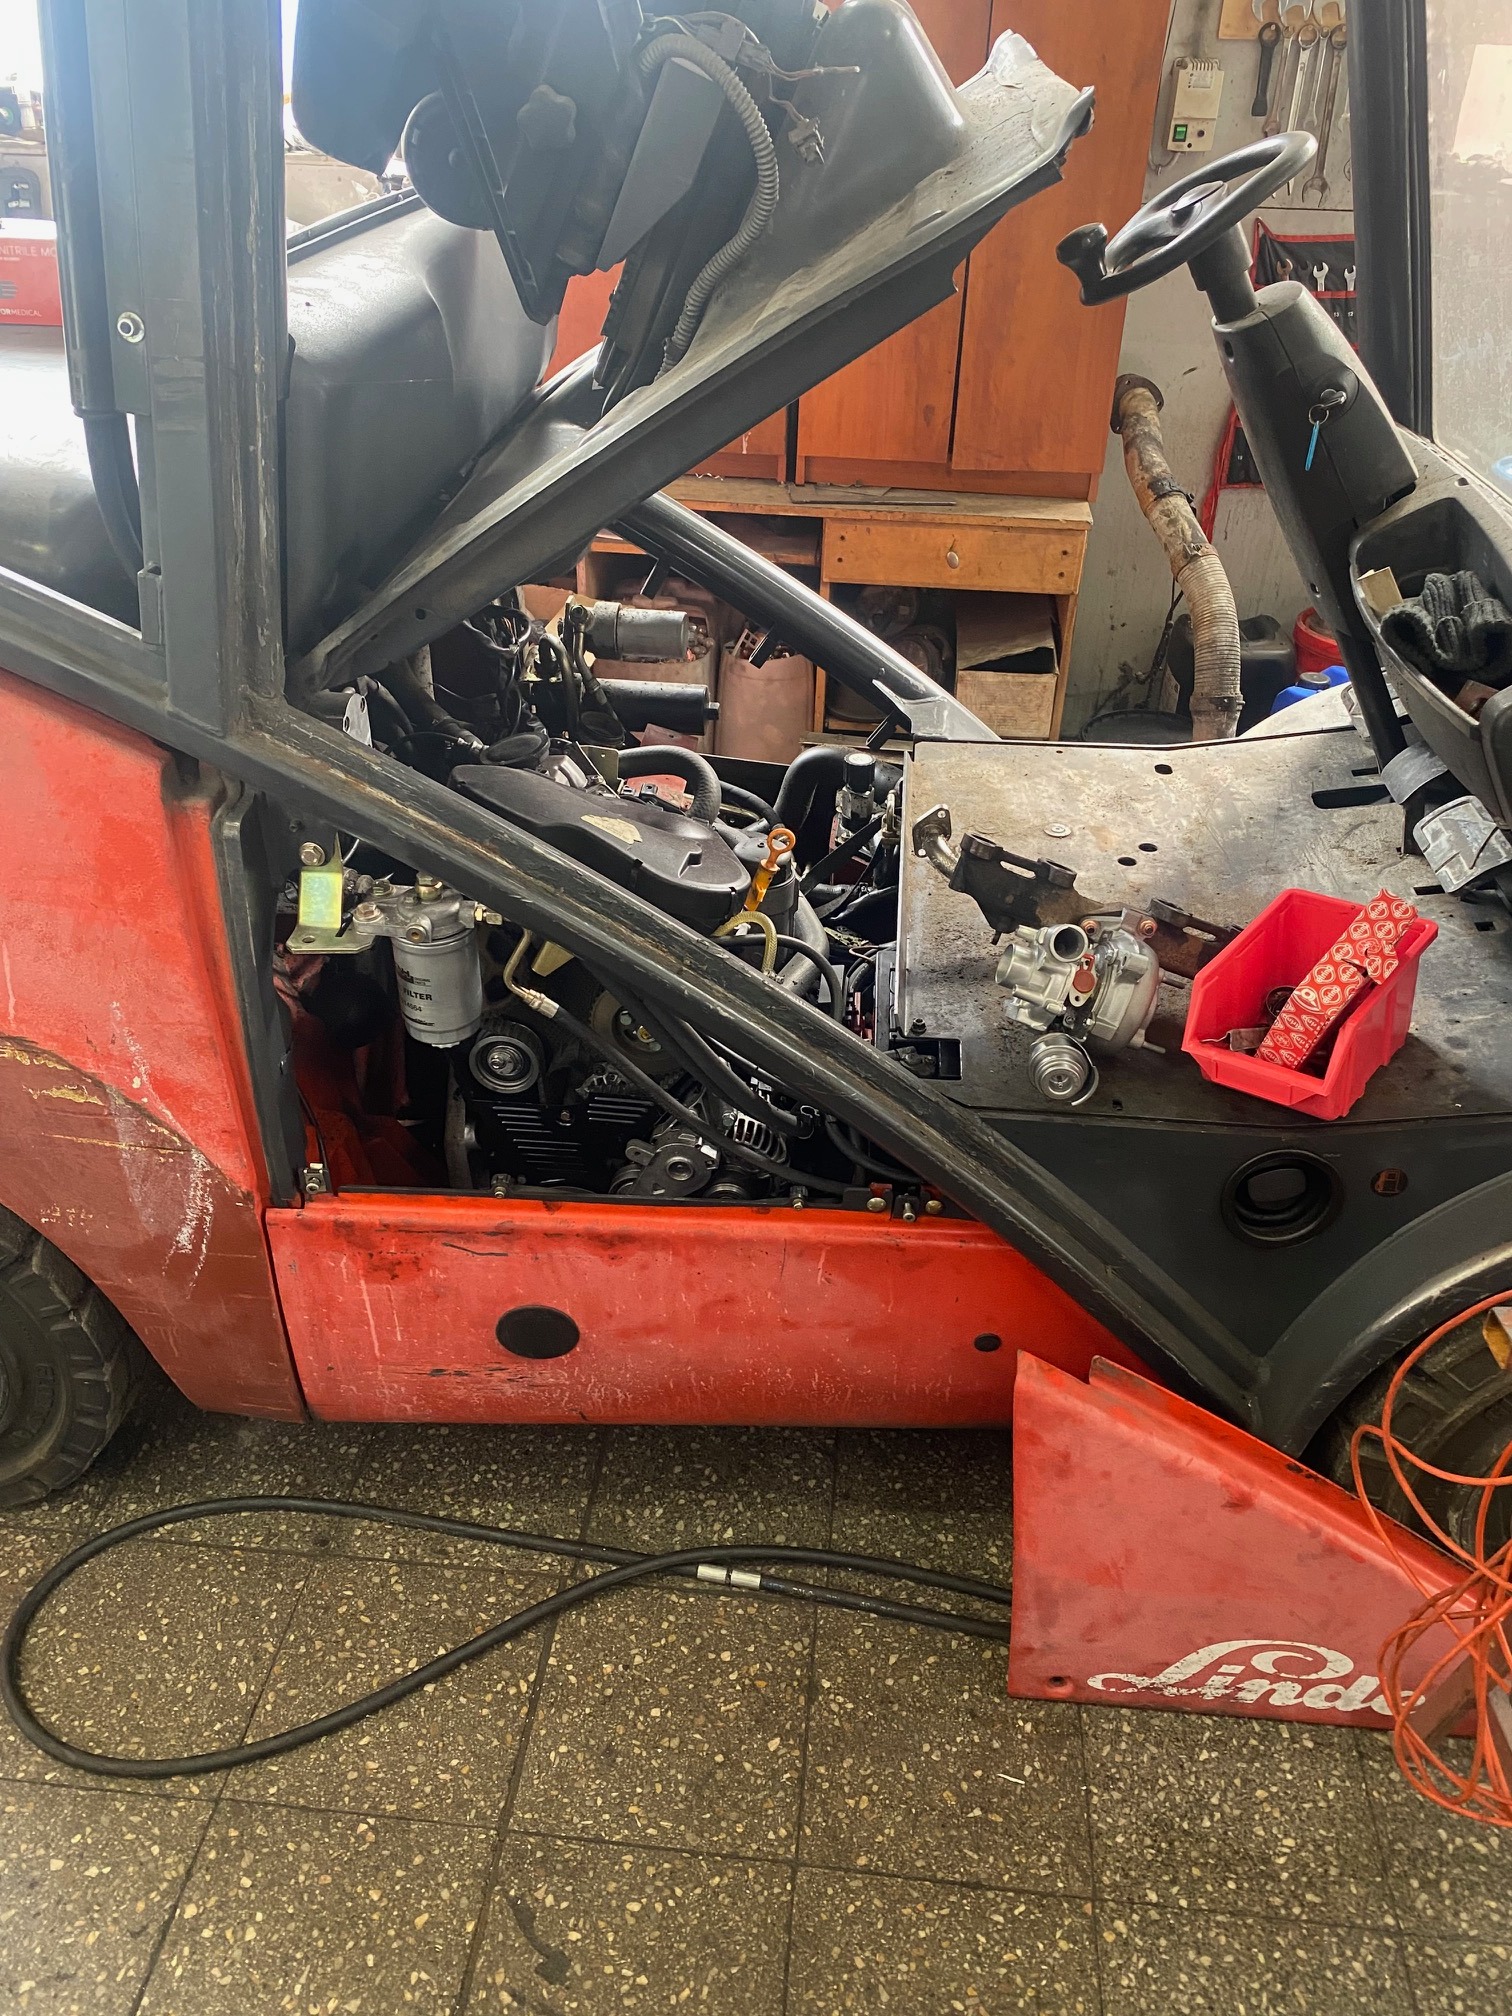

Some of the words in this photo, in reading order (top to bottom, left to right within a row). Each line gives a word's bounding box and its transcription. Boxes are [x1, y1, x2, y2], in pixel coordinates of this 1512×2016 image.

[0, 245, 39, 257] NITRILE
[0, 308, 42, 318] ORMEDICAL
[1087, 1639, 1426, 1716] Linde
